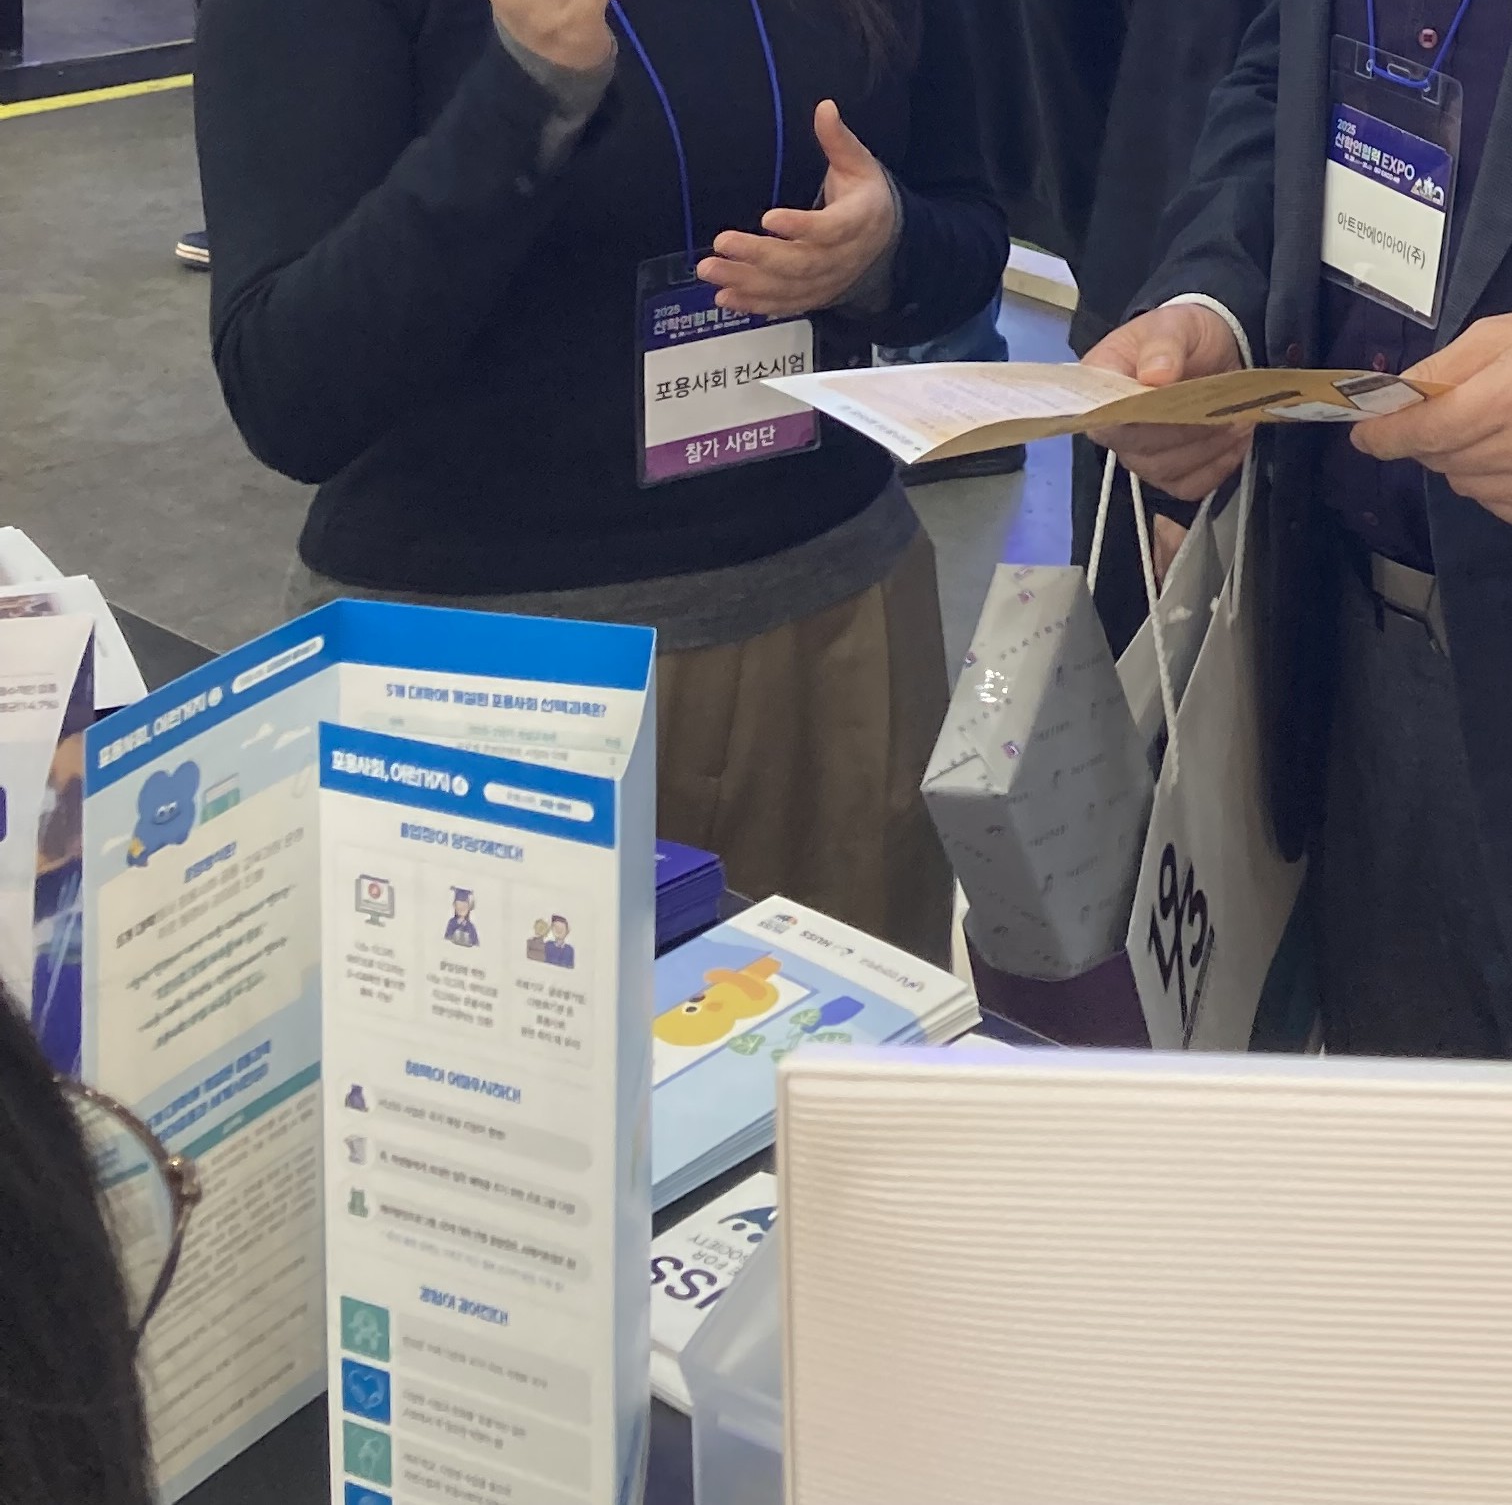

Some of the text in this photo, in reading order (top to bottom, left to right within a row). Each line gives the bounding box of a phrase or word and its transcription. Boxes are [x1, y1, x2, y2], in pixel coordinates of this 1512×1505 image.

[1336, 118, 1357, 136] 2025
[1381, 154, 1416, 181] EXPO
[1337, 211, 1426, 270] 아트만에이아이(주)
[655, 351, 805, 403] 포용사회 컨소시엄
[685, 425, 776, 465] 참가 사업단
